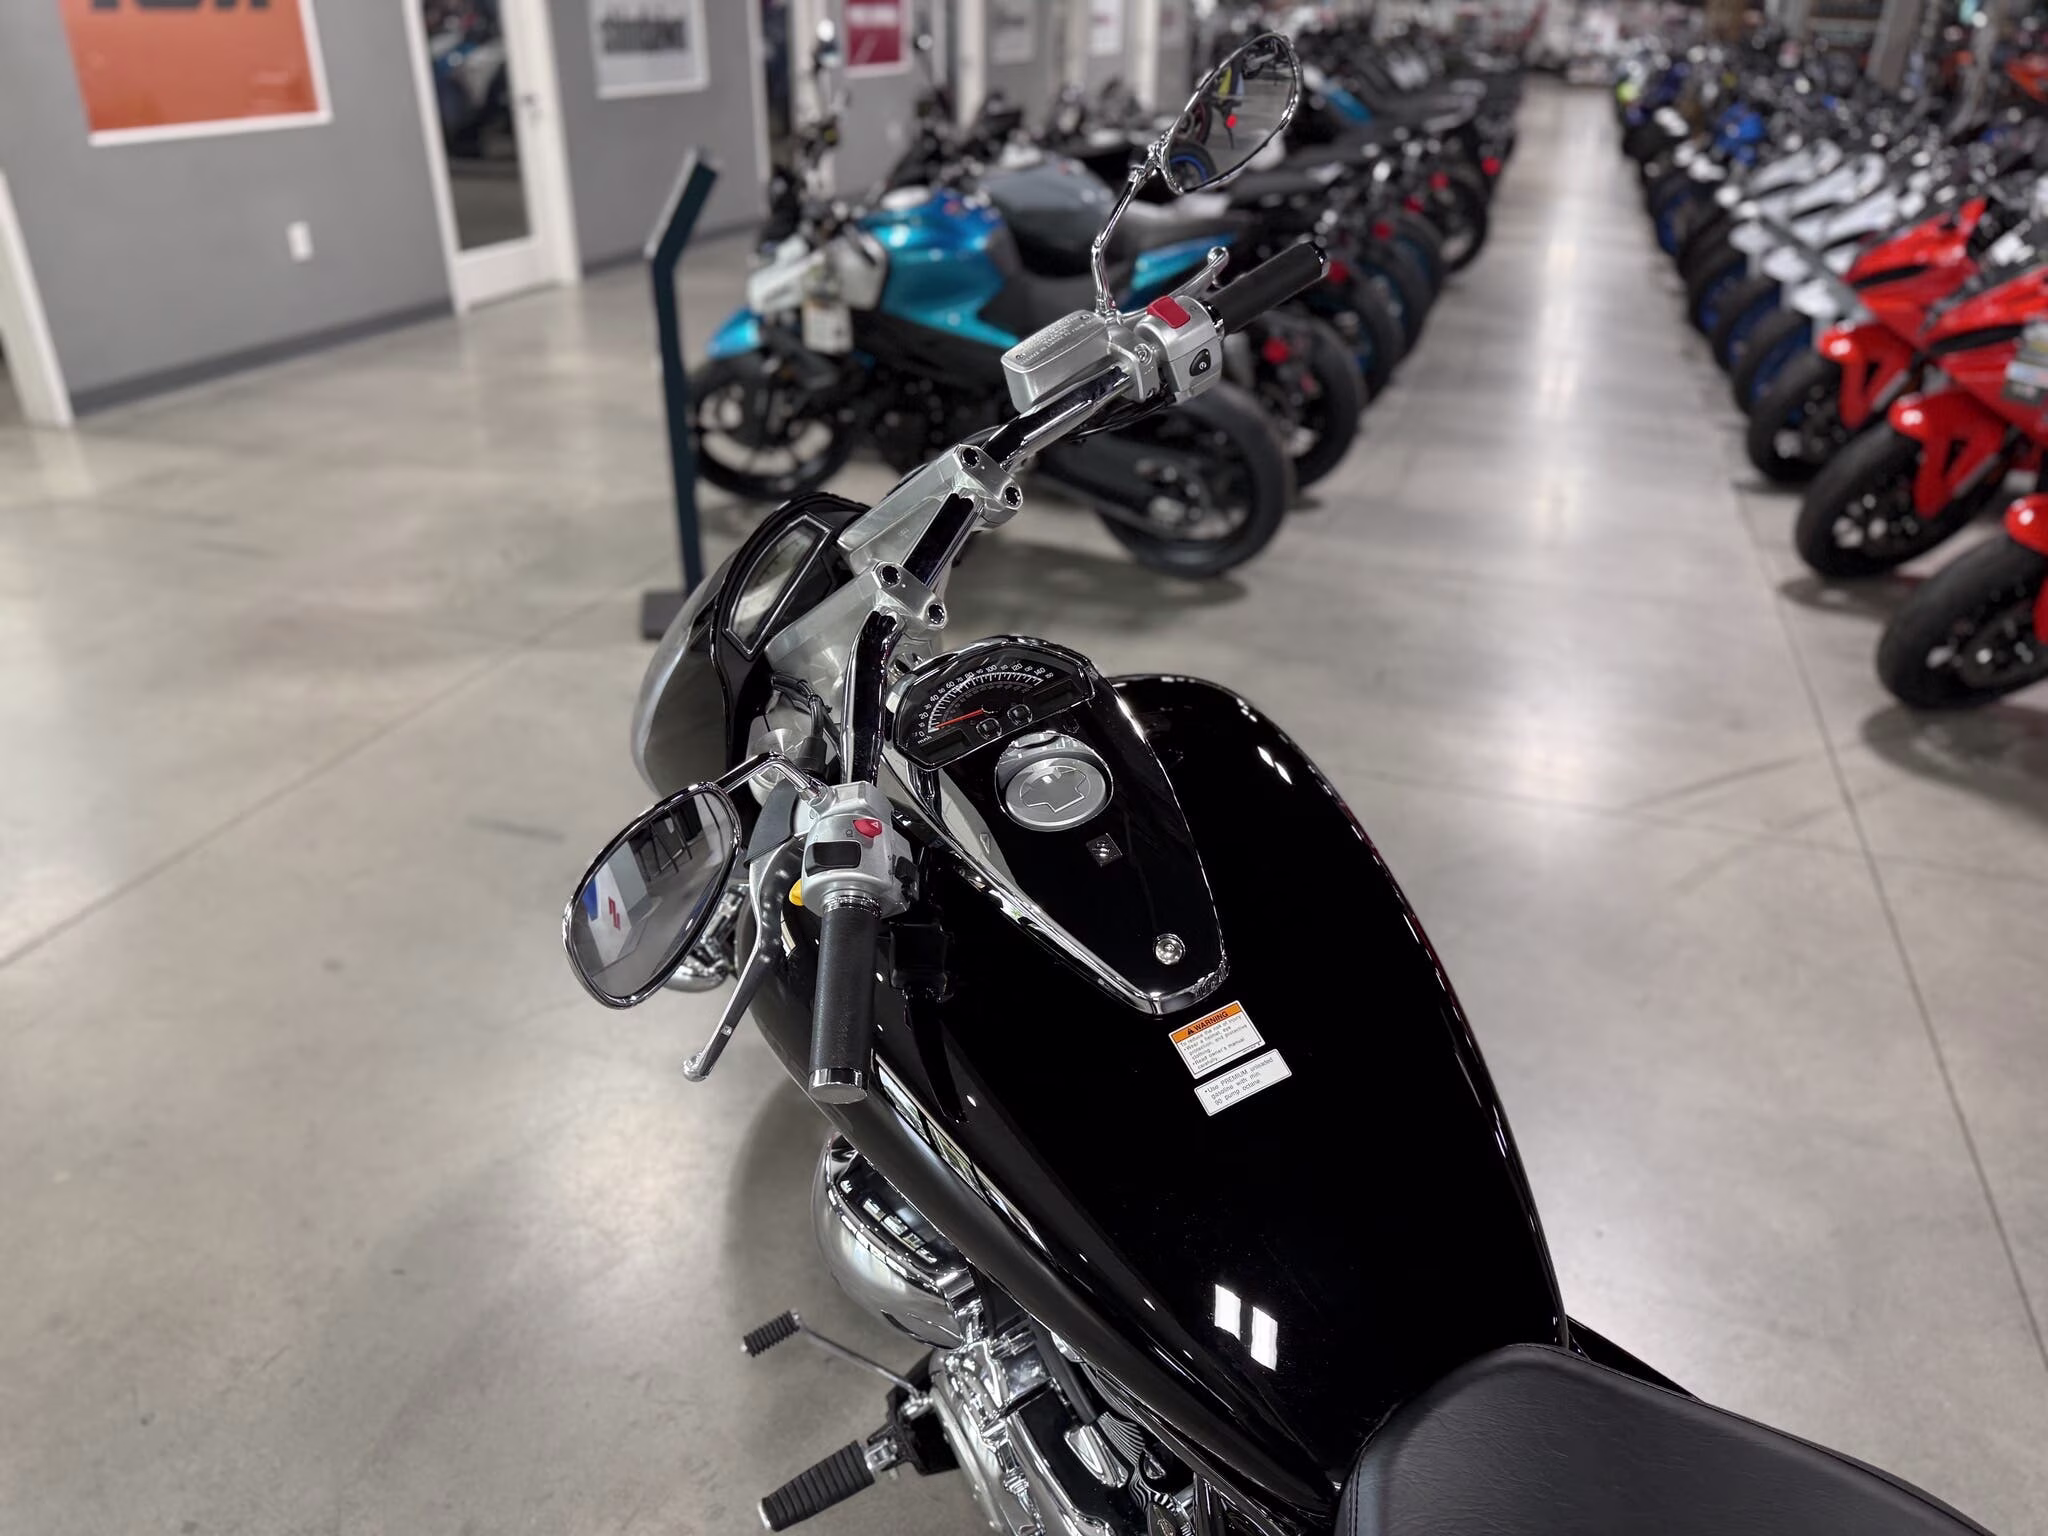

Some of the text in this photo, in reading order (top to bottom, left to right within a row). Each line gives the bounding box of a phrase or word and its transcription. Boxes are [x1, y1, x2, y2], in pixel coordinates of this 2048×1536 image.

[1034, 667, 1046, 676] 140
[1193, 1010, 1228, 1031] WARNING
[1220, 1069, 1248, 1086] PREMIUM
